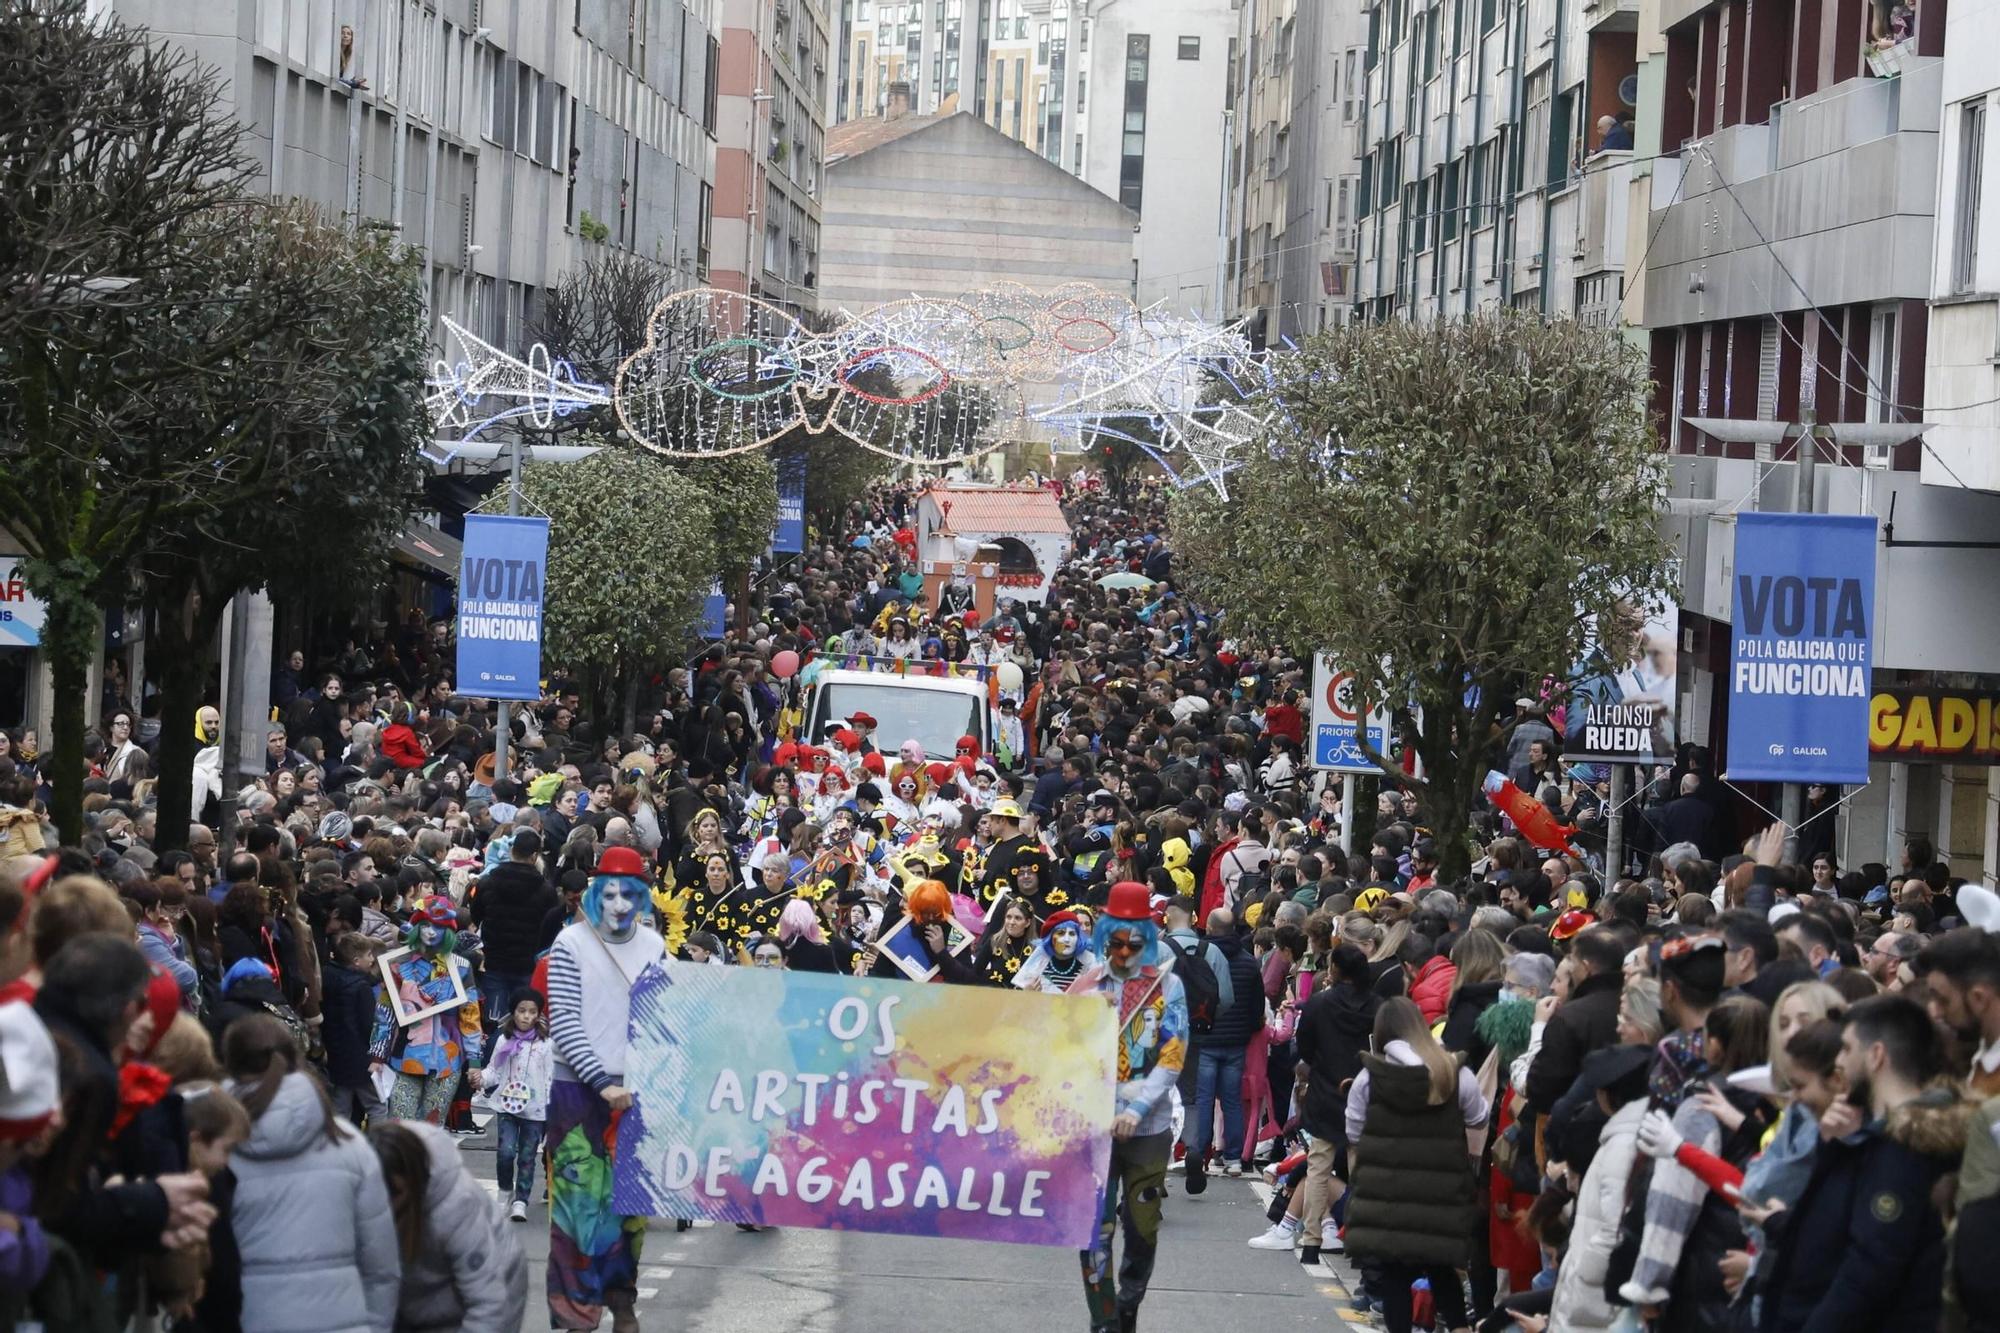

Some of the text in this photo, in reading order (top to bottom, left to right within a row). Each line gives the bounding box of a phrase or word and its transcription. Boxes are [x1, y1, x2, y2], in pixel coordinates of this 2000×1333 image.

[465, 557, 540, 602] VOTA
[462, 600, 539, 618] POLA GALICIA QUE
[1739, 575, 1867, 639] VOTA
[460, 616, 538, 642] FUNCIONA
[1738, 639, 1865, 662] POLA GALICIA QUE
[1735, 662, 1866, 697] FUNCIONA
[1586, 704, 1652, 726] ALFONSO
[1586, 726, 1653, 751] RUEDA
[1793, 747, 1827, 756] GALICIA
[828, 996, 900, 1055] OS
[665, 1144, 1051, 1218] DE AGASALLE
